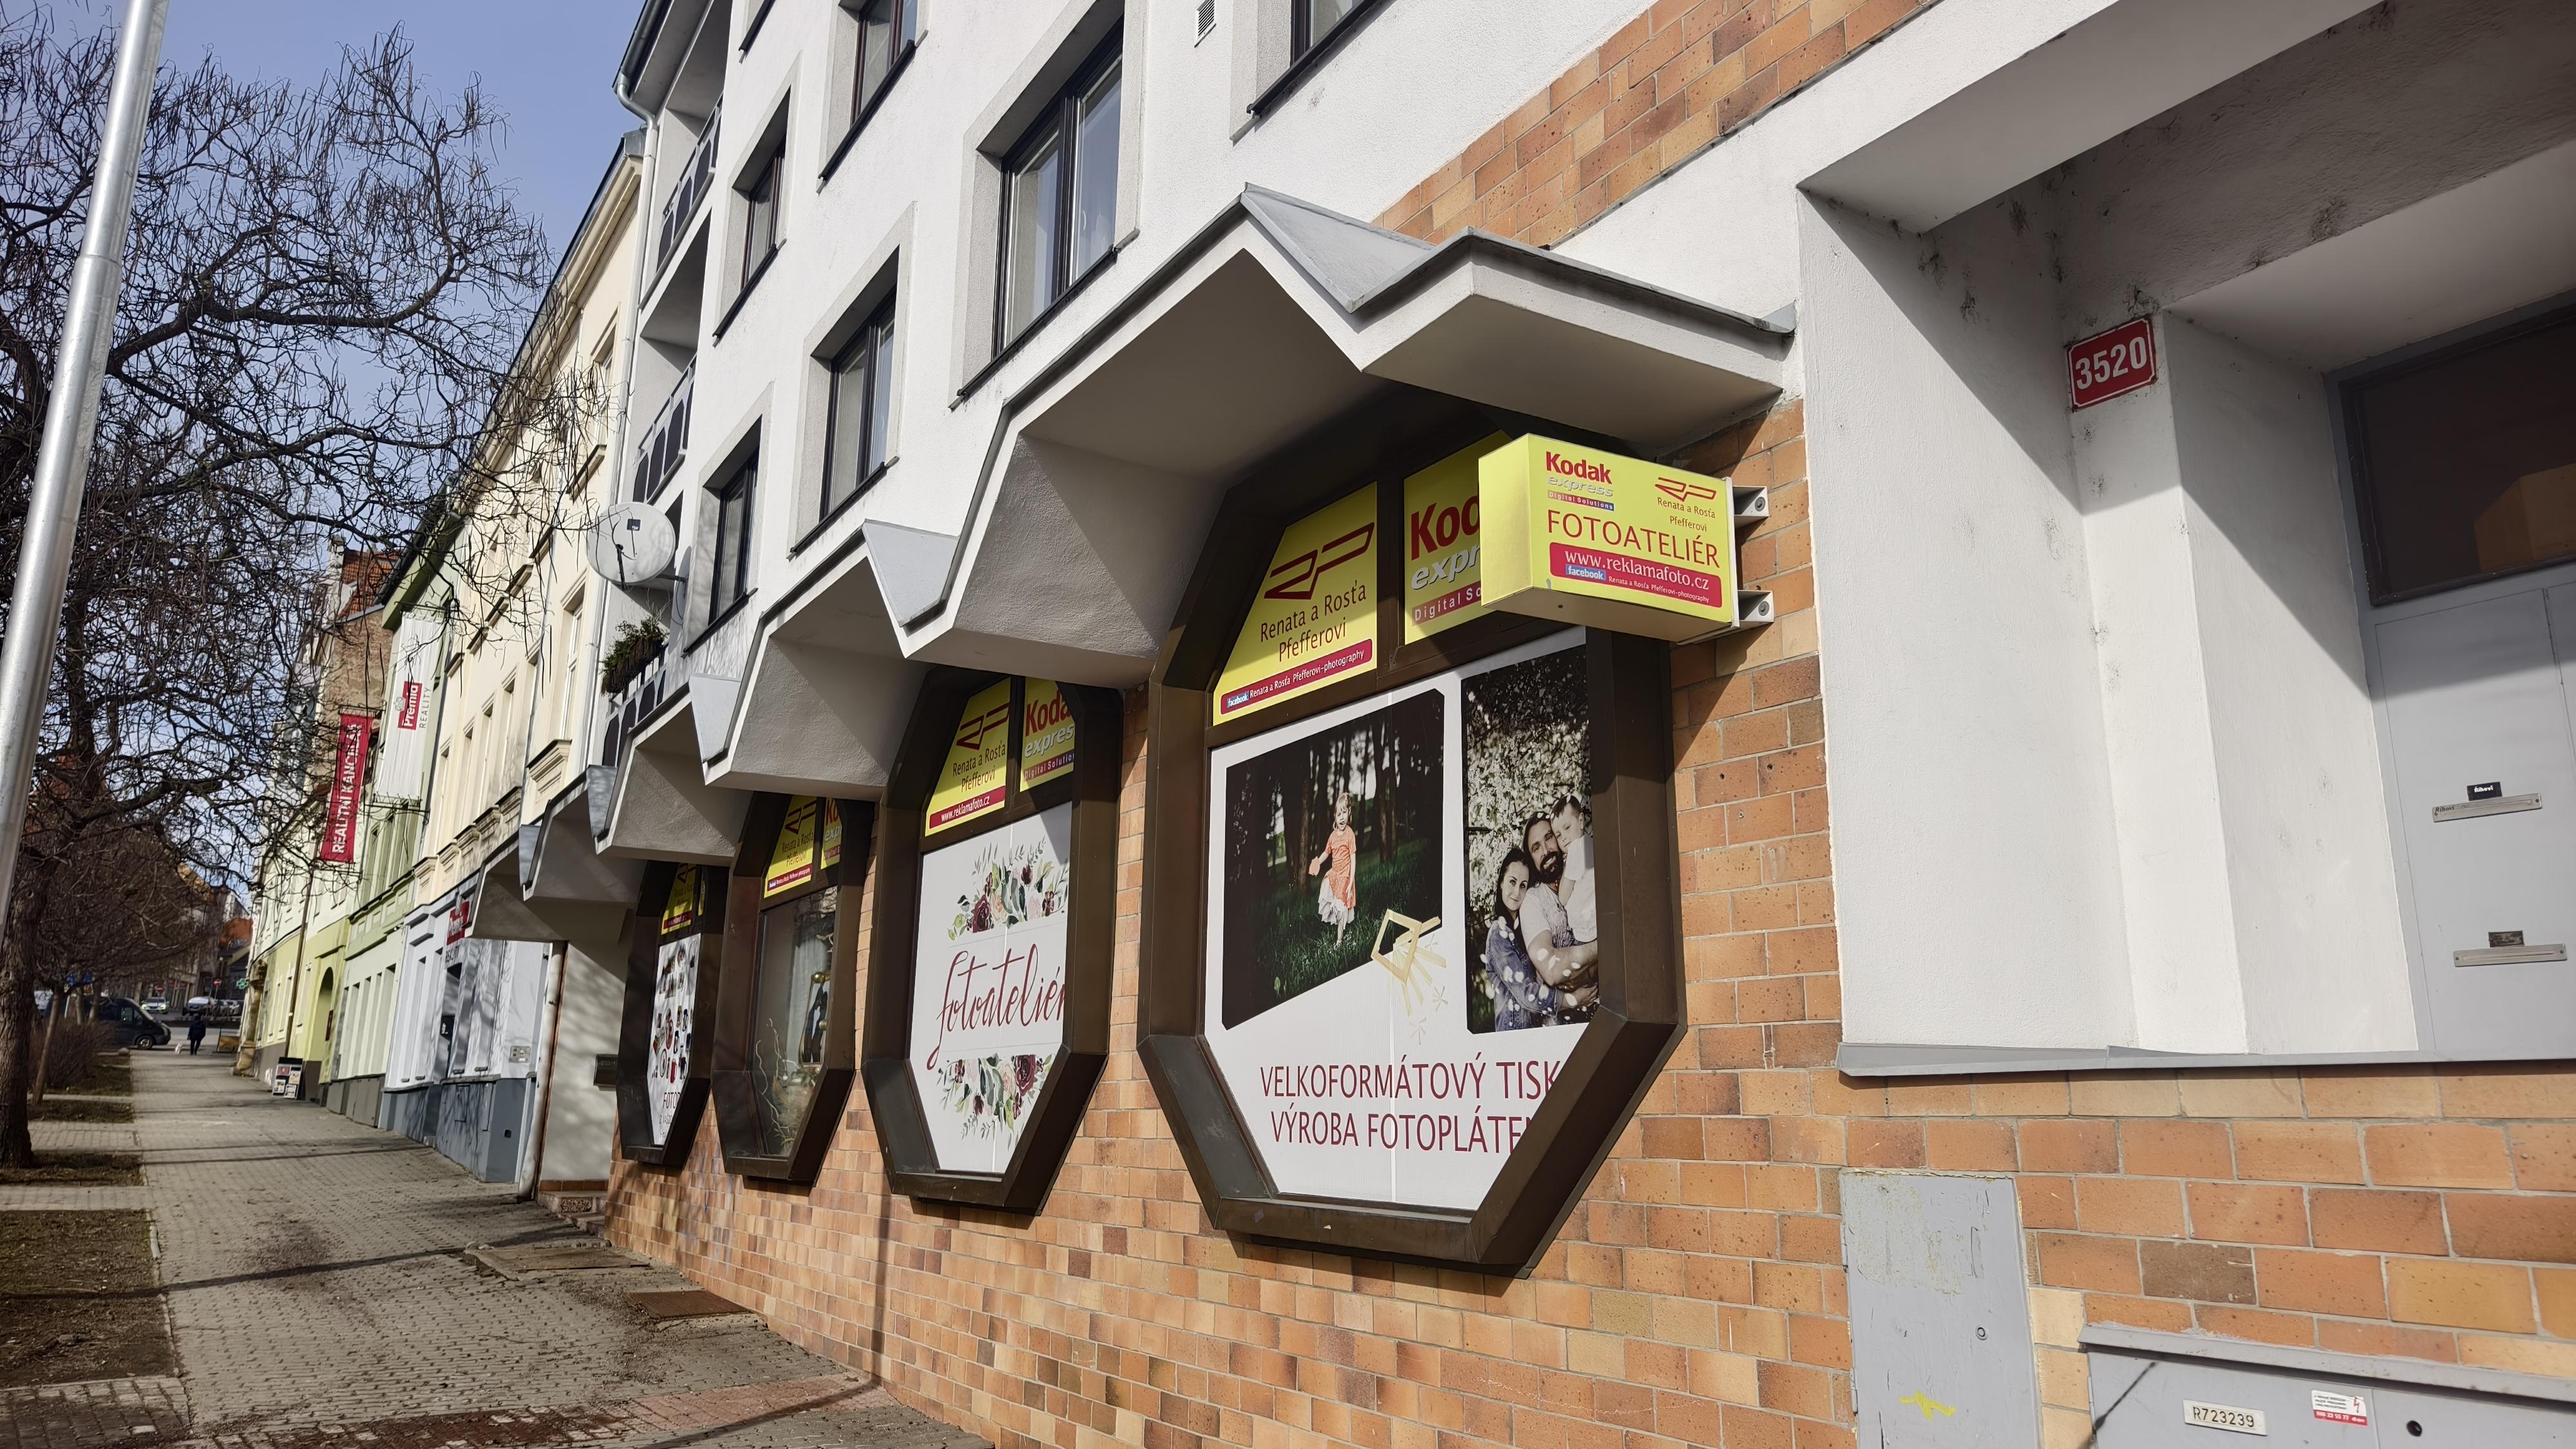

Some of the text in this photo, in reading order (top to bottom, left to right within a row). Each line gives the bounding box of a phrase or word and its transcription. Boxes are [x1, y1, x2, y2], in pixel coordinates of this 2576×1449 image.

[2076, 337, 2147, 390] 3520
[1546, 451, 1612, 484] Kodak
[1547, 476, 1613, 497] express
[1549, 491, 1613, 510] Digital Solutions
[1657, 497, 1684, 511] Renata
[1669, 515, 1707, 532] Pfefferovi
[1548, 509, 1720, 568] FOTOATELIÉR
[1565, 551, 1709, 591] www.reklamafoto.cz
[1567, 566, 1604, 580] facebook
[1609, 576, 1628, 585] Renata
[1415, 592, 1461, 621] Digital
[1260, 611, 1306, 643] Renata
[1311, 605, 1319, 621] a
[1279, 616, 1347, 662] Pfefferovi
[419, 687, 431, 728] REALITY
[1227, 692, 1248, 708] facebook
[1250, 685, 1269, 699] Renata
[952, 757, 976, 777] Renata
[978, 753, 982, 766] a
[961, 765, 996, 793] Pfefferovi
[1025, 762, 1046, 780] Digital
[941, 795, 990, 822] www.reklamafoto.cz
[1260, 1052, 1561, 1099] VELKOFORMÁTOVÝ TISK
[1271, 1102, 1531, 1153] VÝROBA FOTOPLÁTE
[2193, 1406, 2254, 1428] R723239
